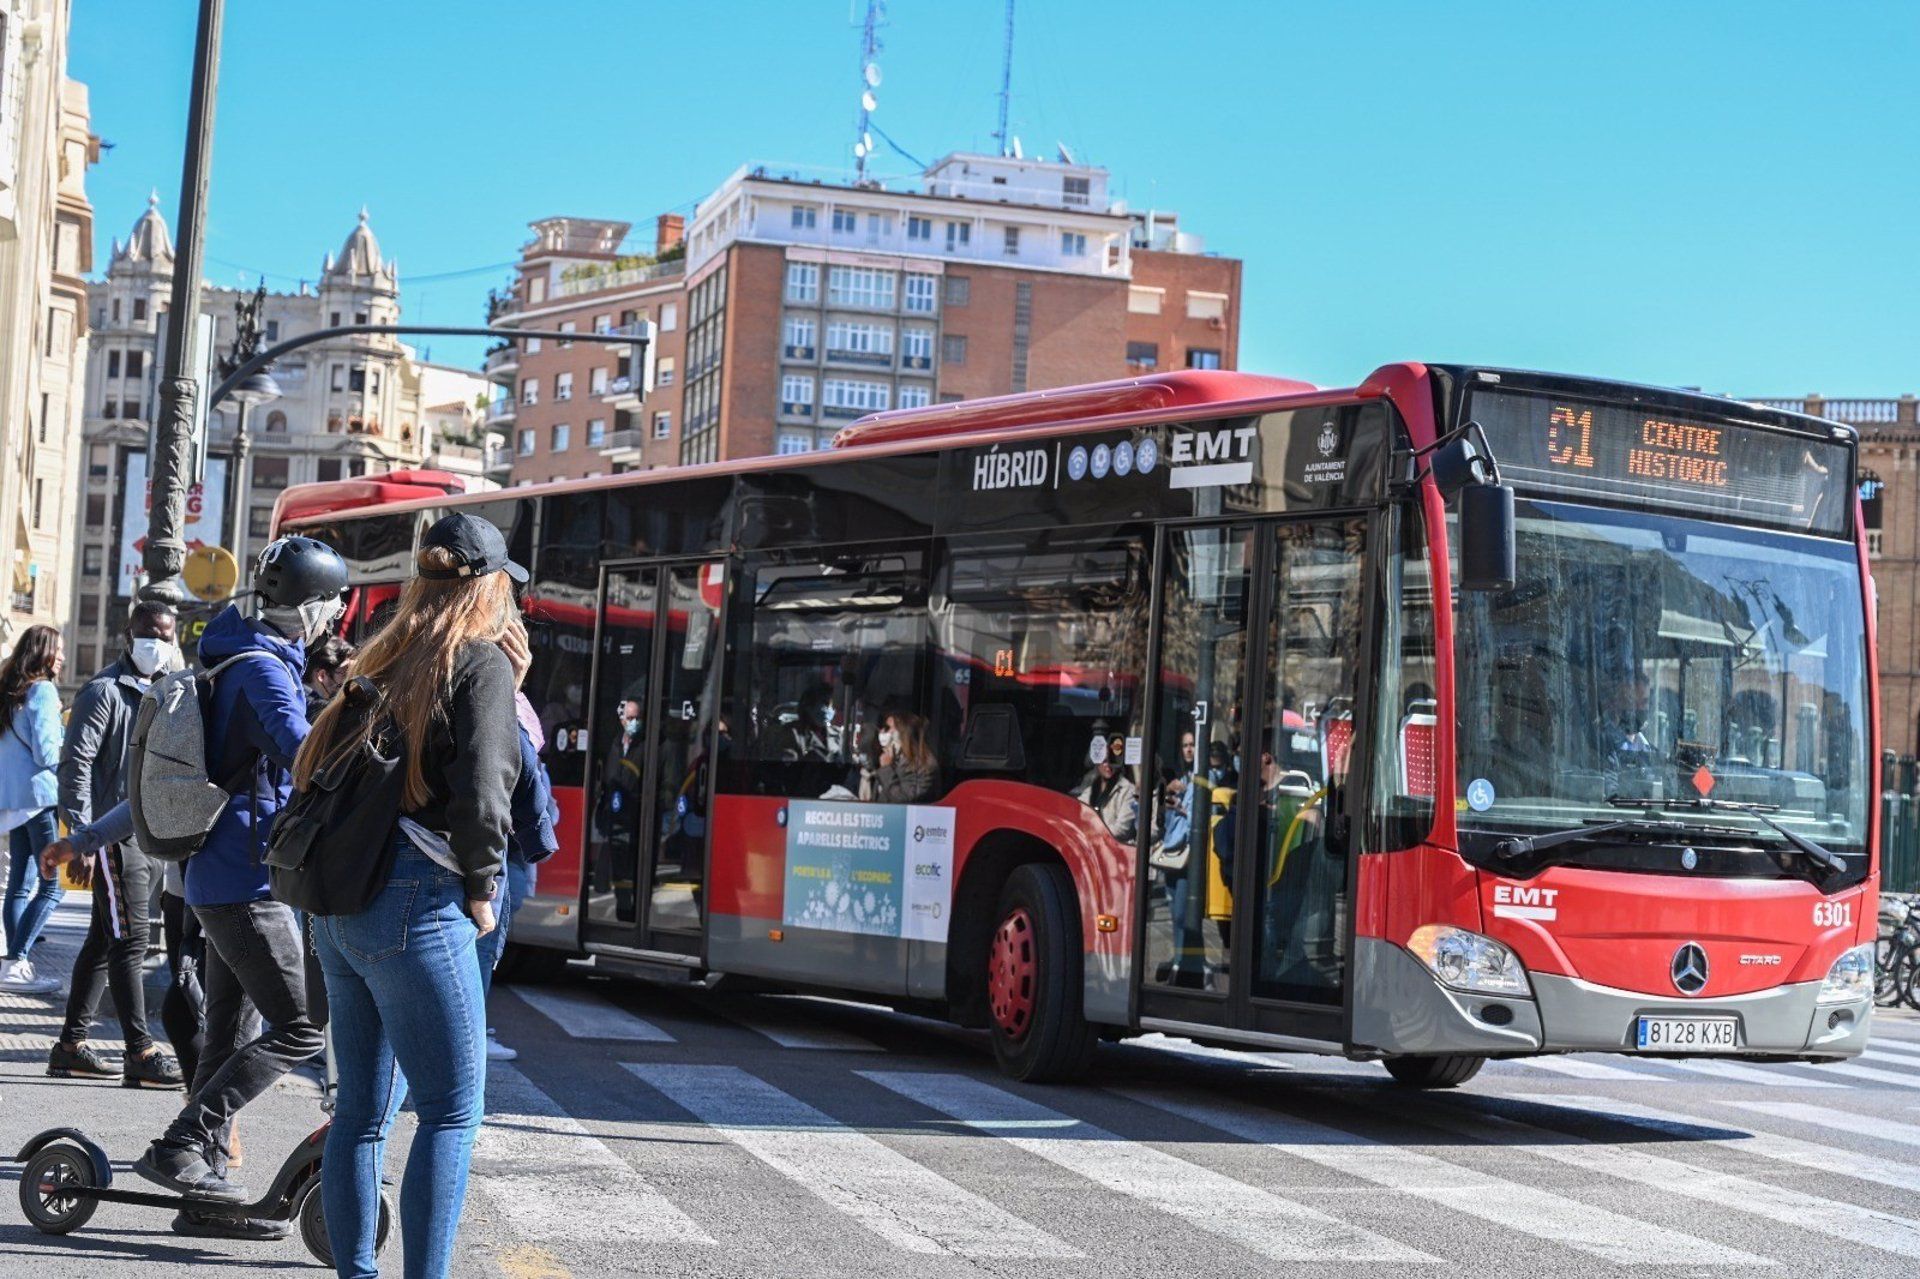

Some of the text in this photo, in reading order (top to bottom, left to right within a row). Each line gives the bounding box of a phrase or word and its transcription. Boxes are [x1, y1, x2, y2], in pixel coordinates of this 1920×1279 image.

[1172, 427, 1256, 462] EMT
[1548, 406, 1594, 468] C1
[1642, 420, 1722, 455] CENTRE
[973, 443, 1048, 490] HÍBRID
[1304, 474, 1313, 483] DE
[1305, 460, 1346, 472] AJUNTAMENT
[1628, 448, 1728, 486] HISTORIC
[994, 649, 1015, 677] C1
[804, 810, 884, 829] RECICLA ELS TEUS
[797, 831, 841, 848] APARELLS
[1494, 885, 1558, 906] EMT
[1813, 902, 1852, 927] 6301
[1650, 1023, 1733, 1044] 8128 KXB
